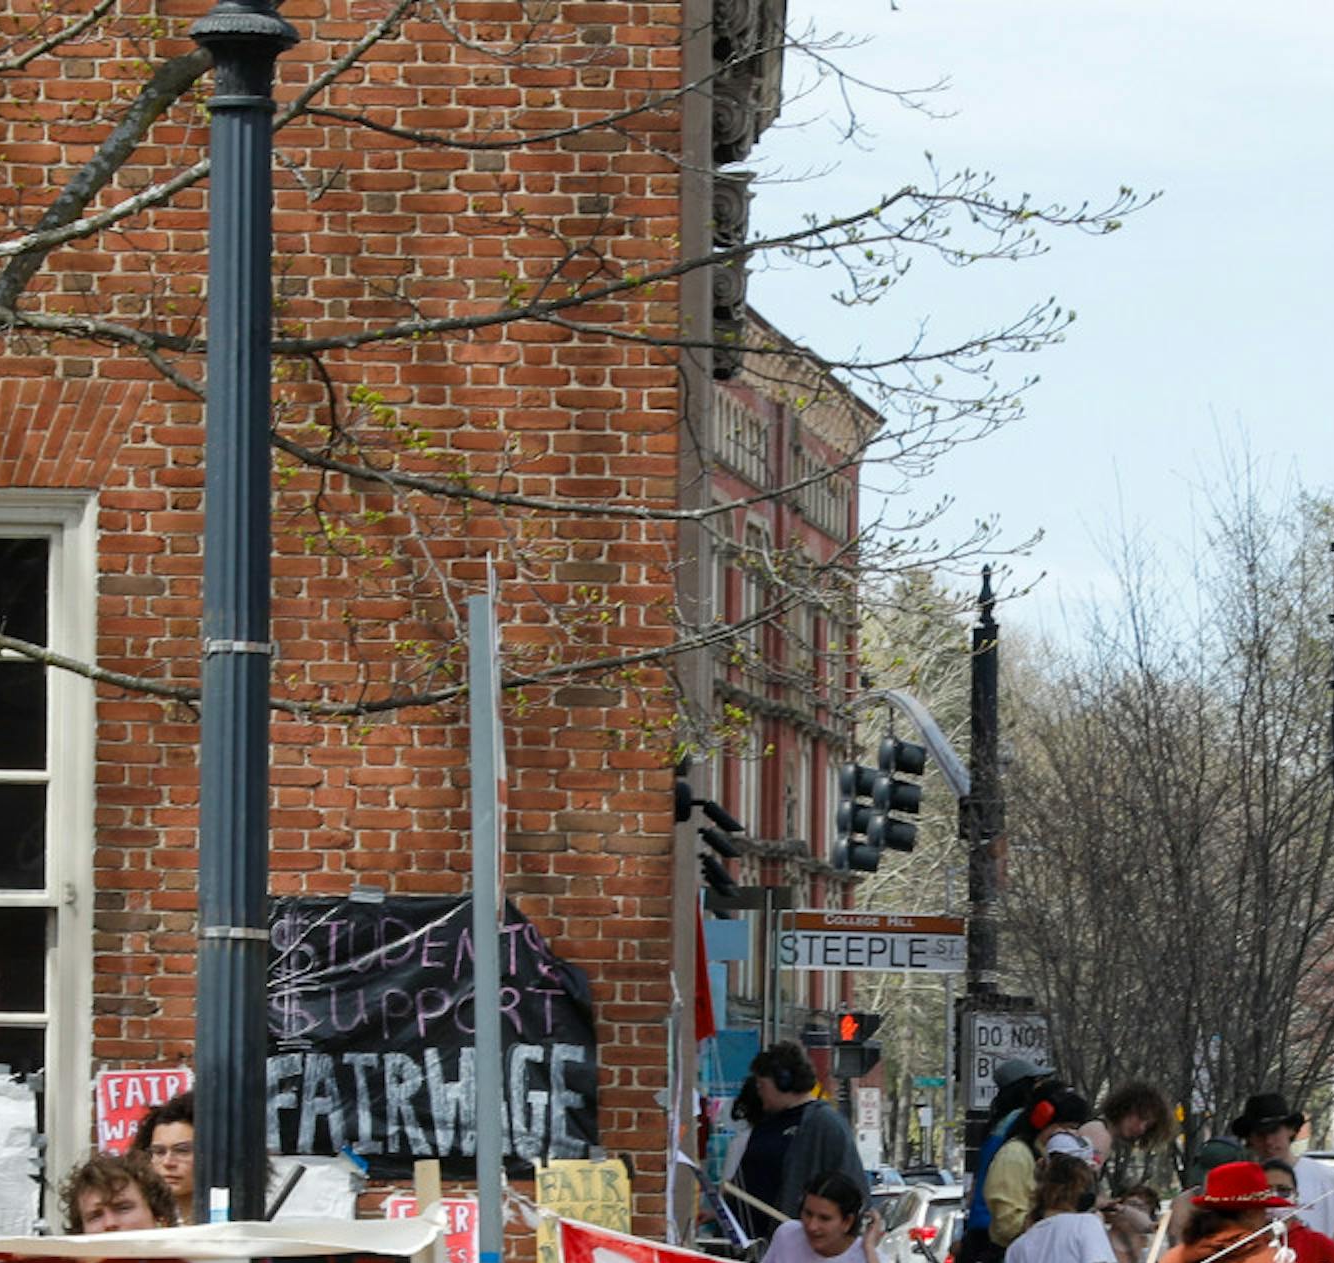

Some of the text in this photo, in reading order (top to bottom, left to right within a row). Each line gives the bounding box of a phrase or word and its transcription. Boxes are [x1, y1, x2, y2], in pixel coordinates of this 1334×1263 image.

[886, 915, 916, 928] HILL
[779, 934, 928, 968] STEEPLE
[978, 1026, 1001, 1047] DO
[266, 1041, 589, 1162] FAIR WGE
